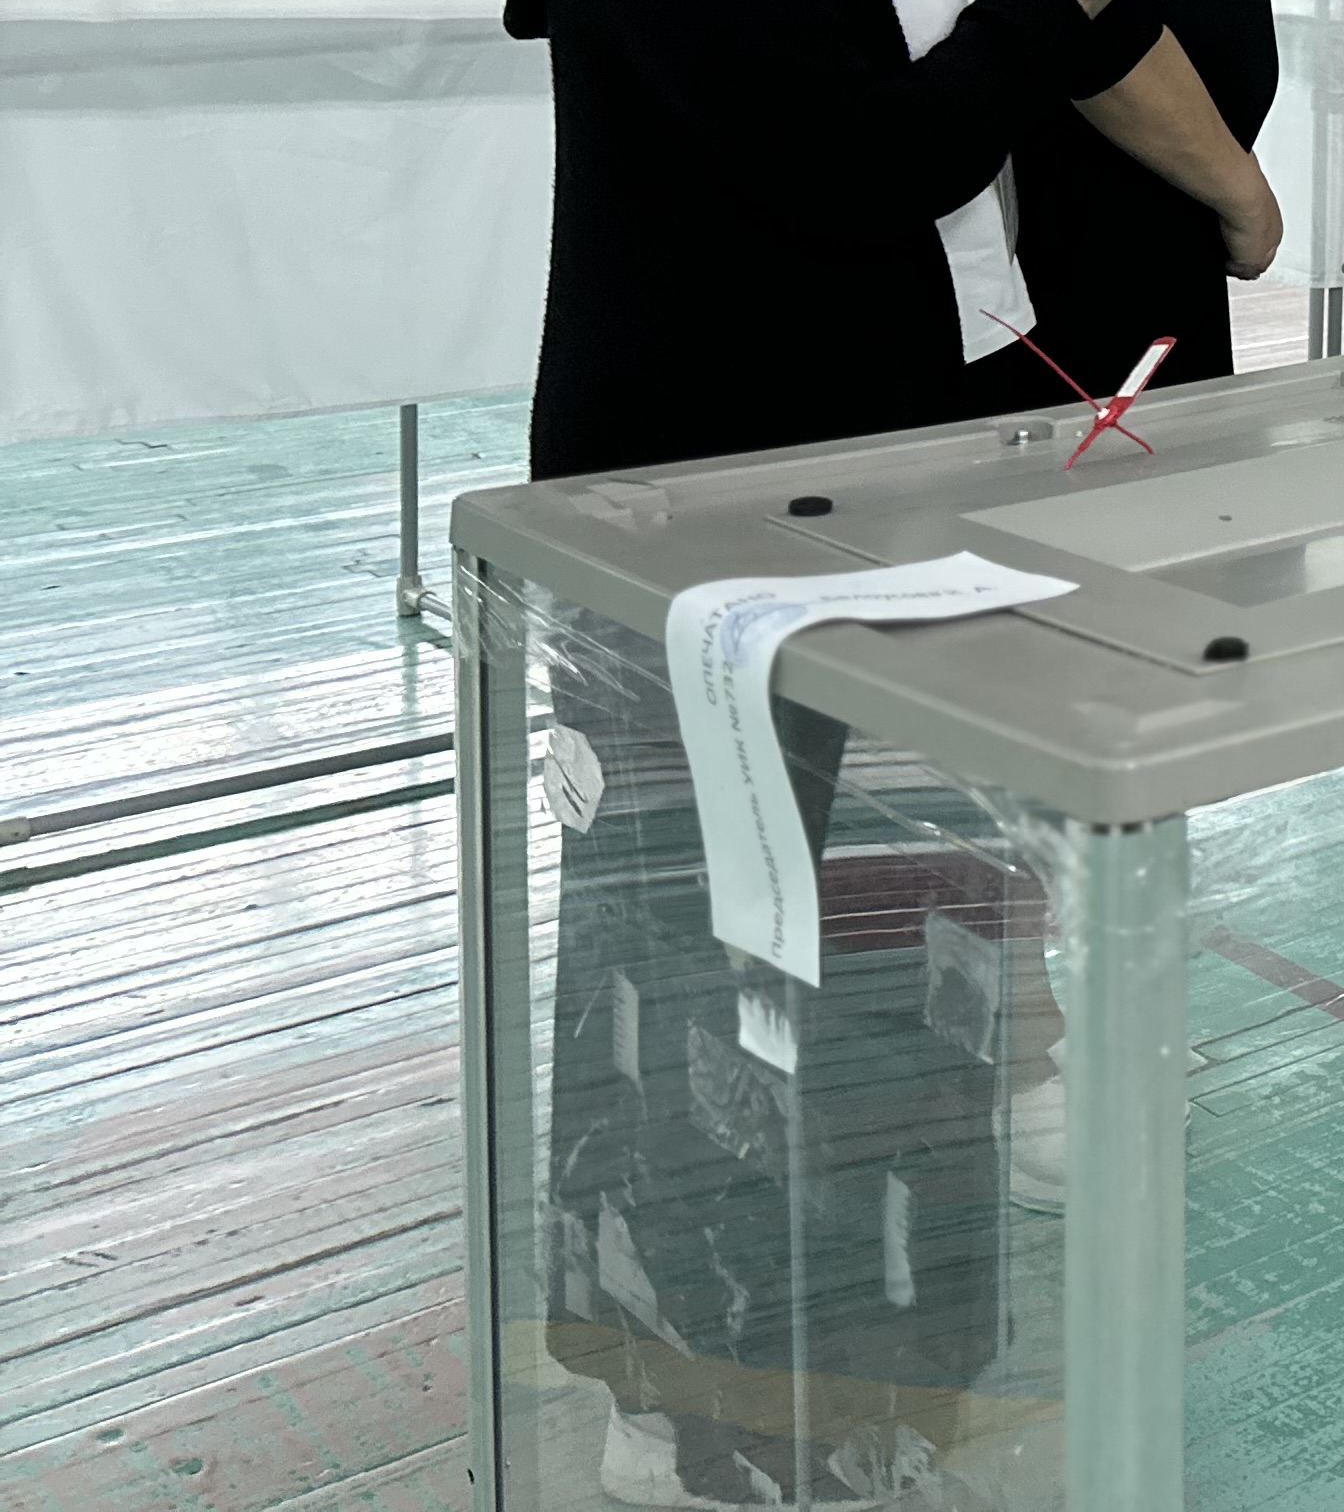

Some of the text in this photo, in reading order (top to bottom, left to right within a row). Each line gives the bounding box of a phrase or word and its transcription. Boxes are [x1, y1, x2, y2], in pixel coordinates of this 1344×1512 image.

[701, 592, 777, 706] ОПЕЧАТАНО
[723, 661, 743, 733] №732
[733, 738, 754, 786] УИК
[749, 792, 786, 959] Председатель
